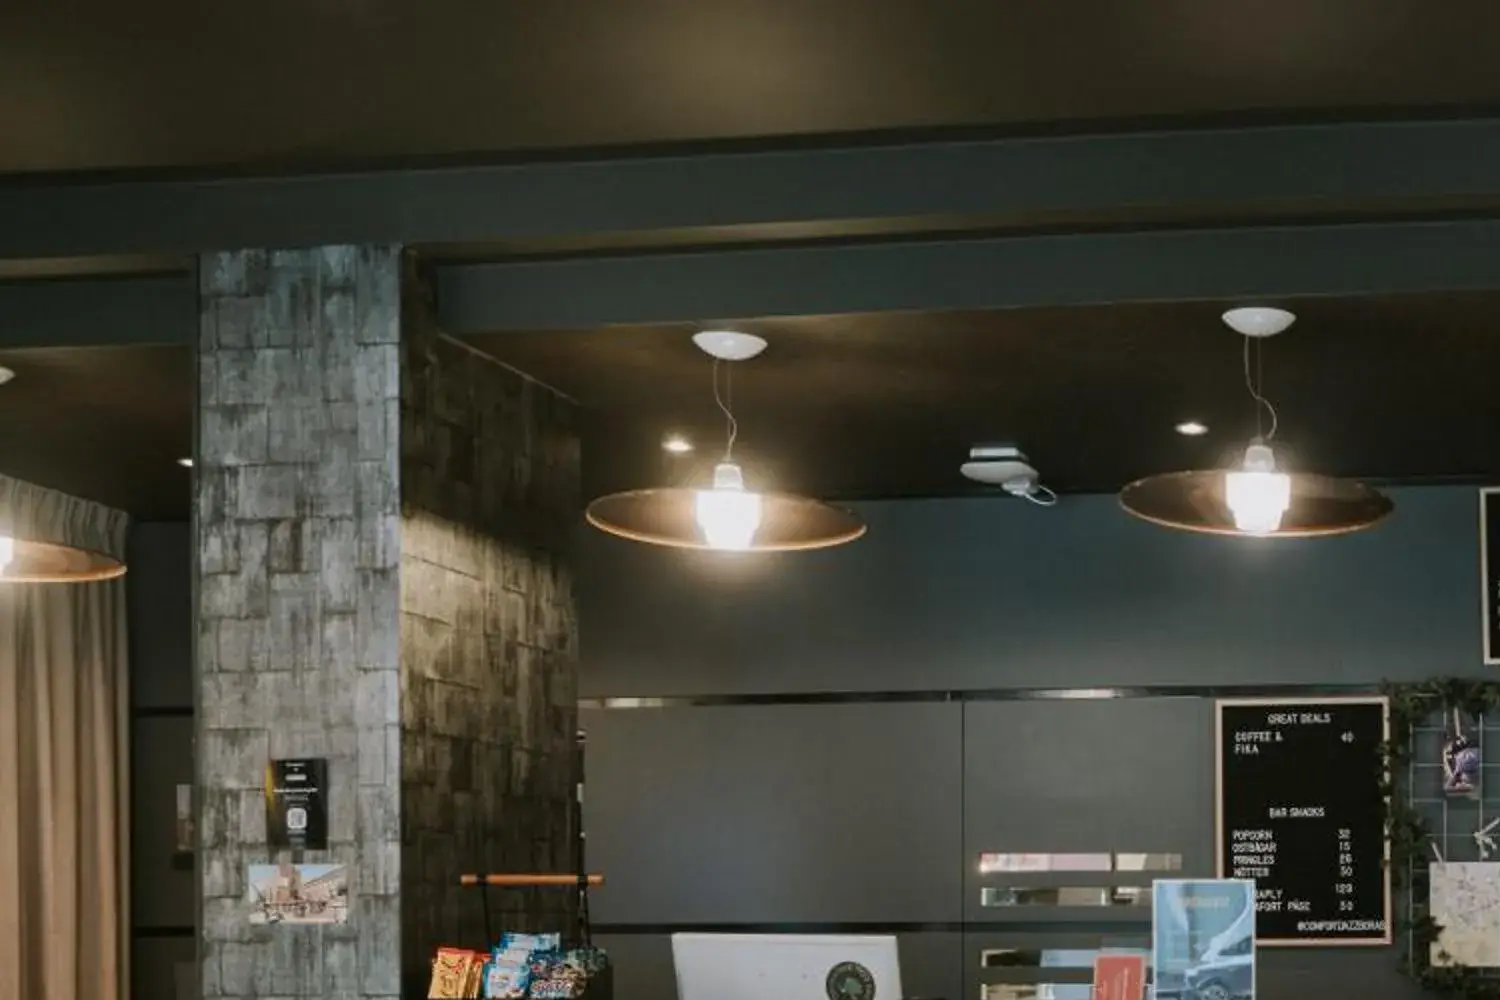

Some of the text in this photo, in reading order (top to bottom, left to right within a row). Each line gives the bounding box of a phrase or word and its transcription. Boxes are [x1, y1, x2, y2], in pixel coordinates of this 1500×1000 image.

[1267, 712, 1332, 724] GREAT DEALS
[1234, 731, 1272, 742] COFFEE
[1234, 744, 1259, 754] FIKA
[1269, 806, 1326, 818] BAR SNACKS
[1232, 829, 1273, 841] POPCORN
[1254, 901, 1283, 912] FORT
